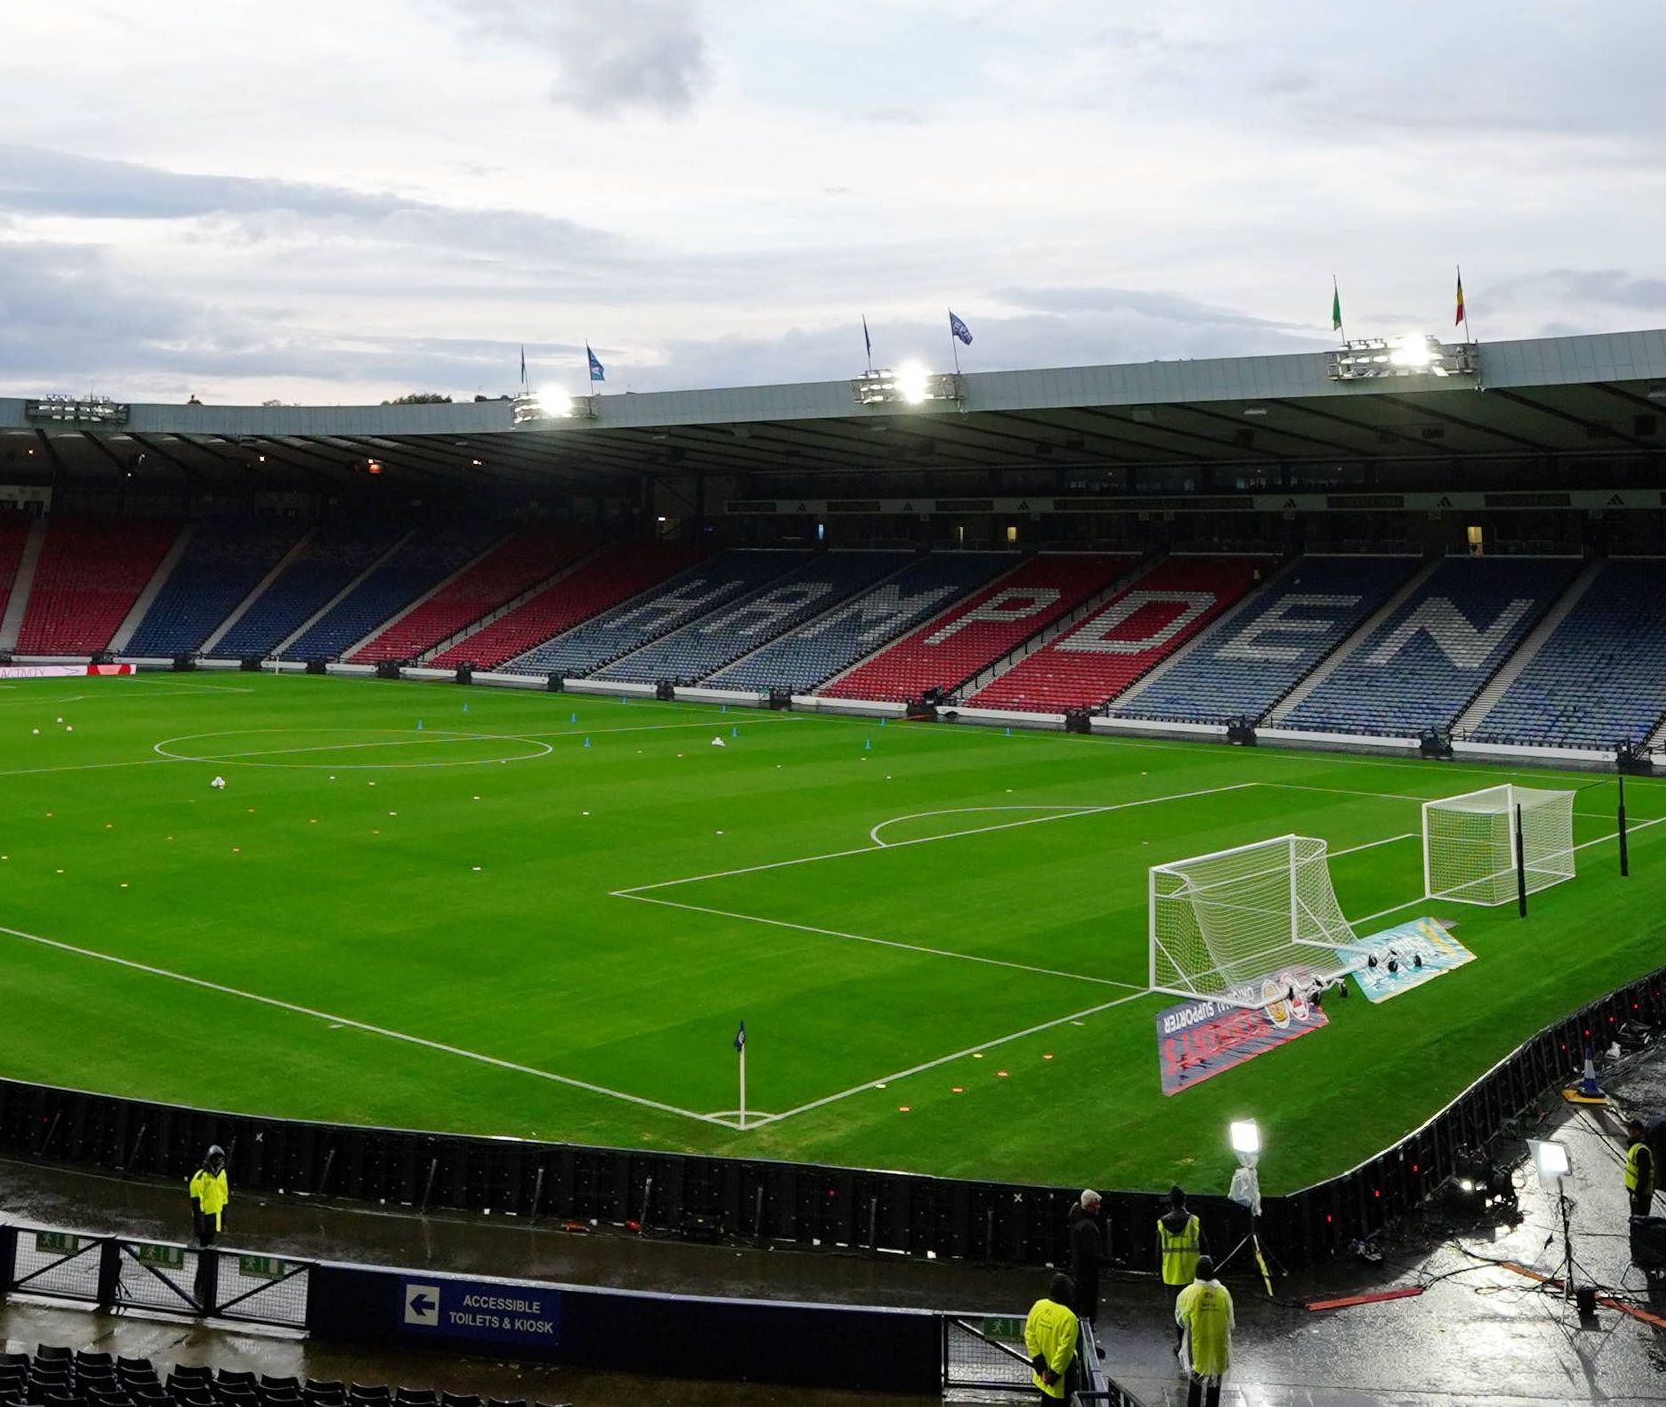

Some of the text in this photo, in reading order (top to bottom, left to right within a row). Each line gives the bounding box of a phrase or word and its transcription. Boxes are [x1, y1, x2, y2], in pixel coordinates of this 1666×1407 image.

[601, 579, 1535, 670] HAMPDEN
[1163, 1001, 1215, 1034] SUPPORTER
[462, 1294, 541, 1314] ACCESSIBLE
[449, 1311, 554, 1334] TOILETS & KIOSK
